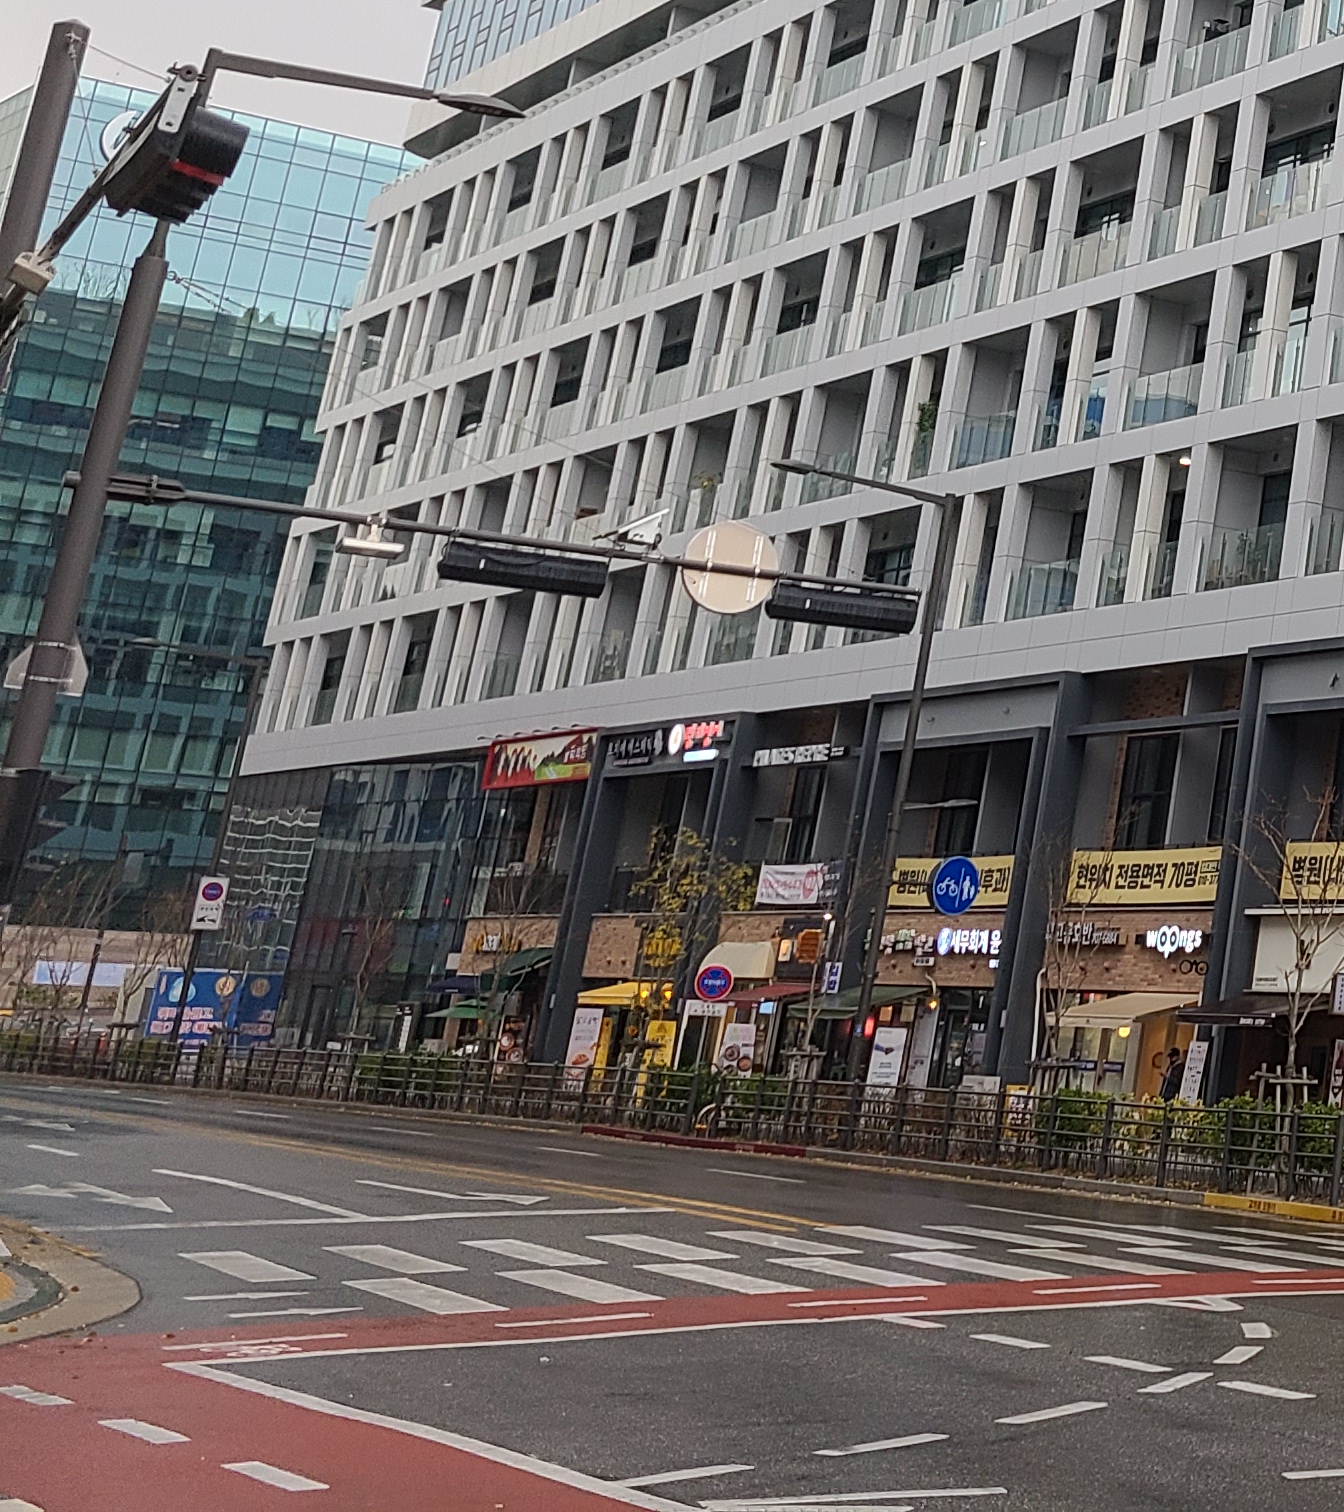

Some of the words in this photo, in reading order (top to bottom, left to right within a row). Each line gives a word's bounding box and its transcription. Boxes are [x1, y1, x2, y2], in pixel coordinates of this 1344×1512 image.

[1075, 862, 1114, 890] 현위치
[1114, 861, 1169, 890] 전용면적
[1168, 860, 1200, 889] 70평
[950, 928, 989, 954] 세무회계
